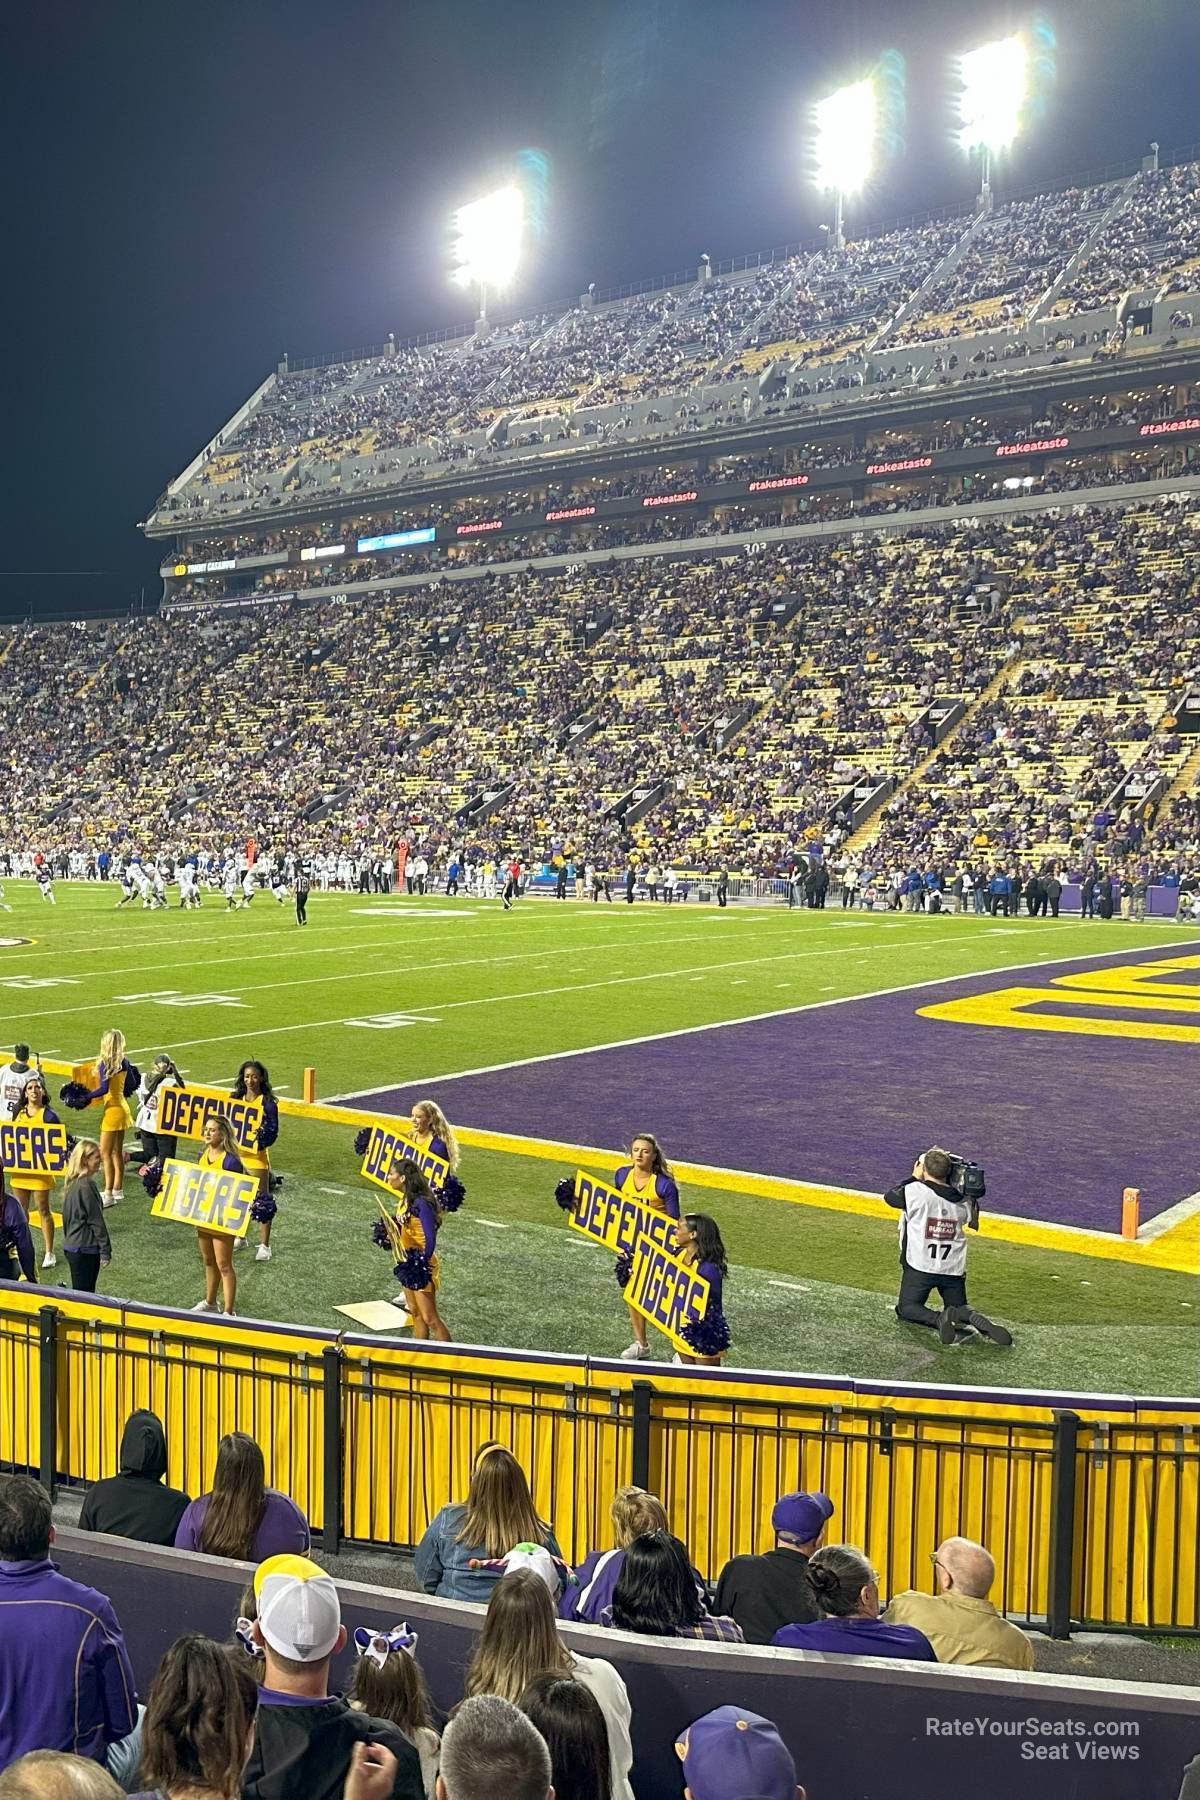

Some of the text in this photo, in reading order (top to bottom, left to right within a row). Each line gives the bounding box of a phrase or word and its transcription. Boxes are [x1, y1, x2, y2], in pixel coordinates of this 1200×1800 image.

[1140, 418, 1200, 436] #takeata
[996, 437, 1069, 456] #takeataste
[866, 457, 932, 475] #takeataste
[749, 475, 808, 492] #takeataste
[643, 491, 697, 506] #takeataste
[546, 506, 596, 521] #takeataste
[457, 520, 502, 535] #takeataste
[330, 595, 347, 605] 300
[160, 1165, 254, 1231] TIGERS
[928, 1226, 954, 1234] BUREAU
[927, 1243, 952, 1260] 17
[630, 1243, 705, 1336] TIGERS
